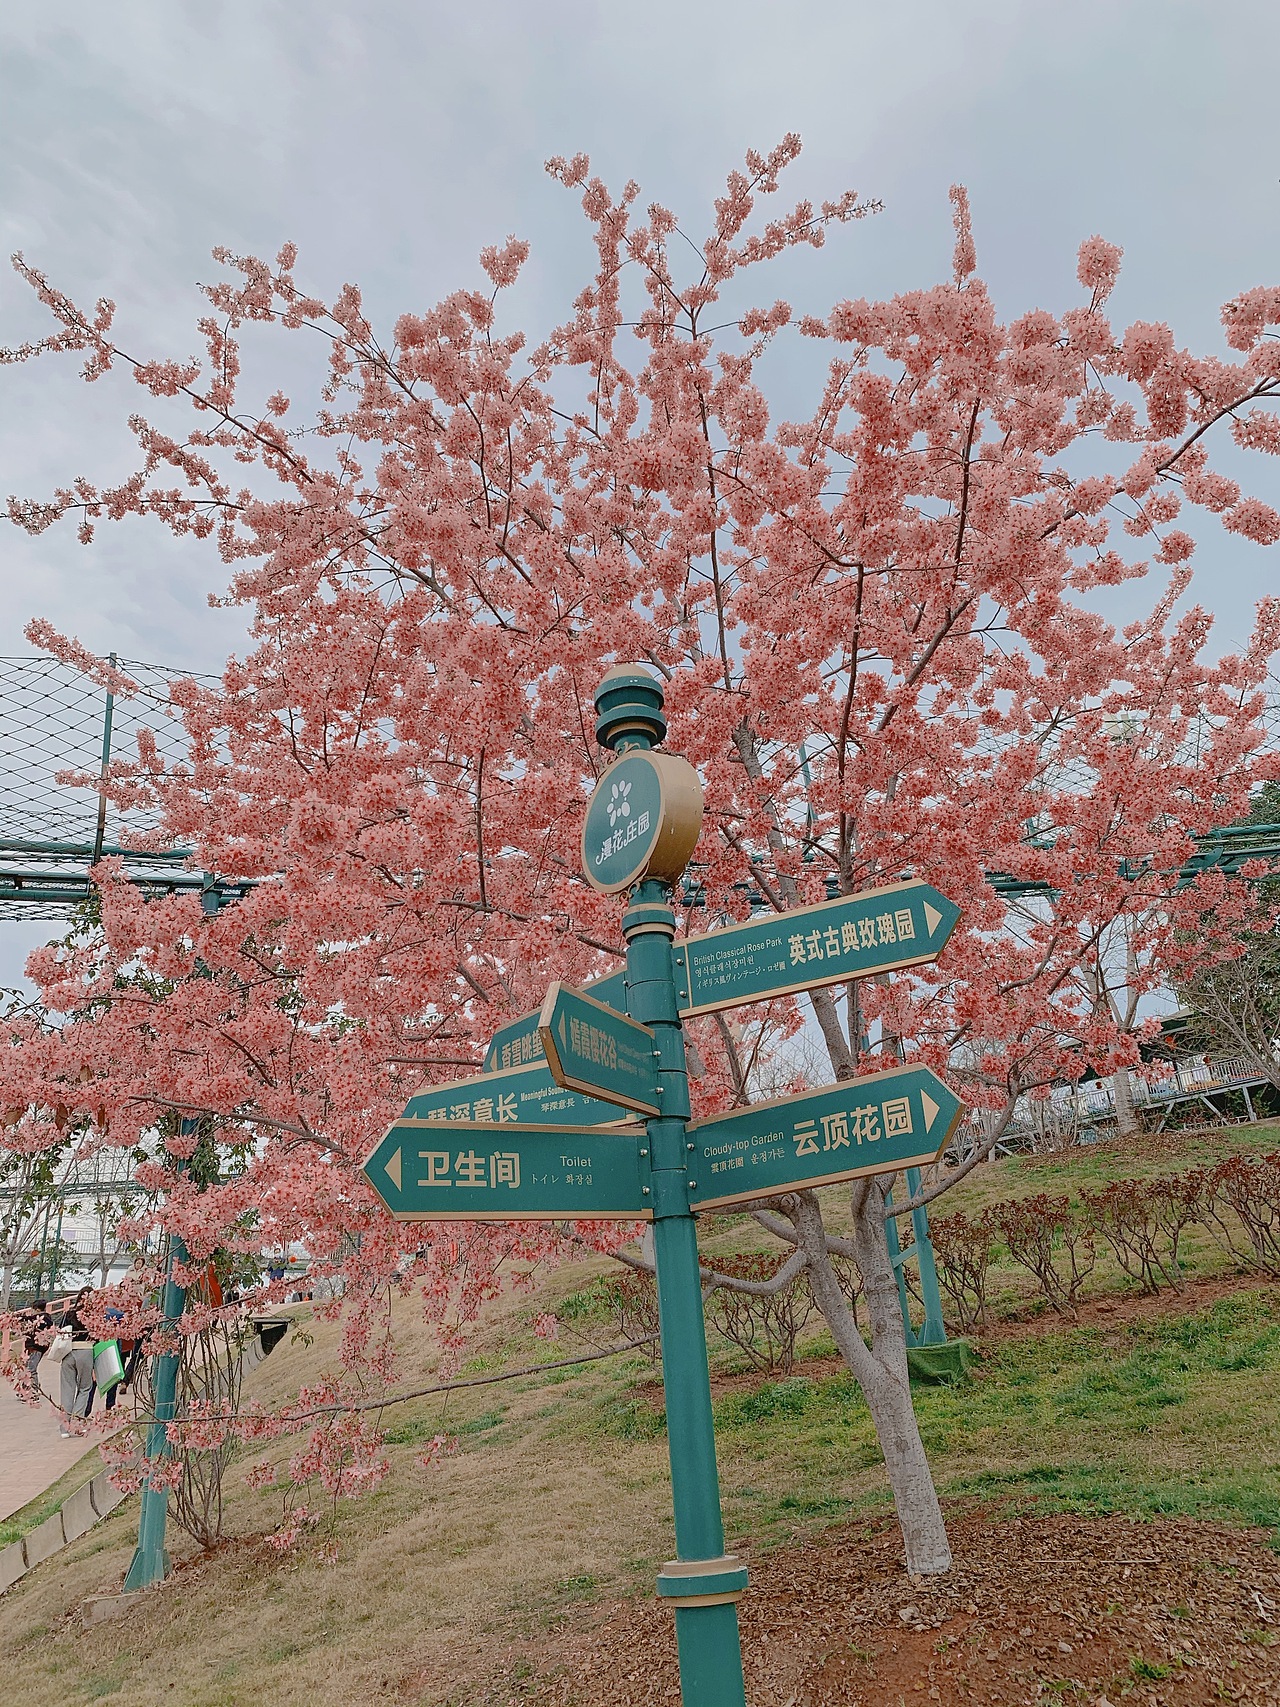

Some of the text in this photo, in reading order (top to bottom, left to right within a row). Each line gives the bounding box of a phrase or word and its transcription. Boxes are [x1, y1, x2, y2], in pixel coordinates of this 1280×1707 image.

[595, 811, 650, 865] 漫花庄园
[693, 936, 783, 966] British Classical Rose Park
[788, 908, 916, 967] 英式古典玫瑰园
[520, 1087, 548, 1102] Meaningful
[792, 1096, 914, 1157] 云顶花园
[703, 1131, 784, 1158] Cloudy-top Garden
[417, 1150, 521, 1189] 卫生间
[559, 1155, 592, 1168] Toilet
[532, 1173, 593, 1186] トイレ 화장실
